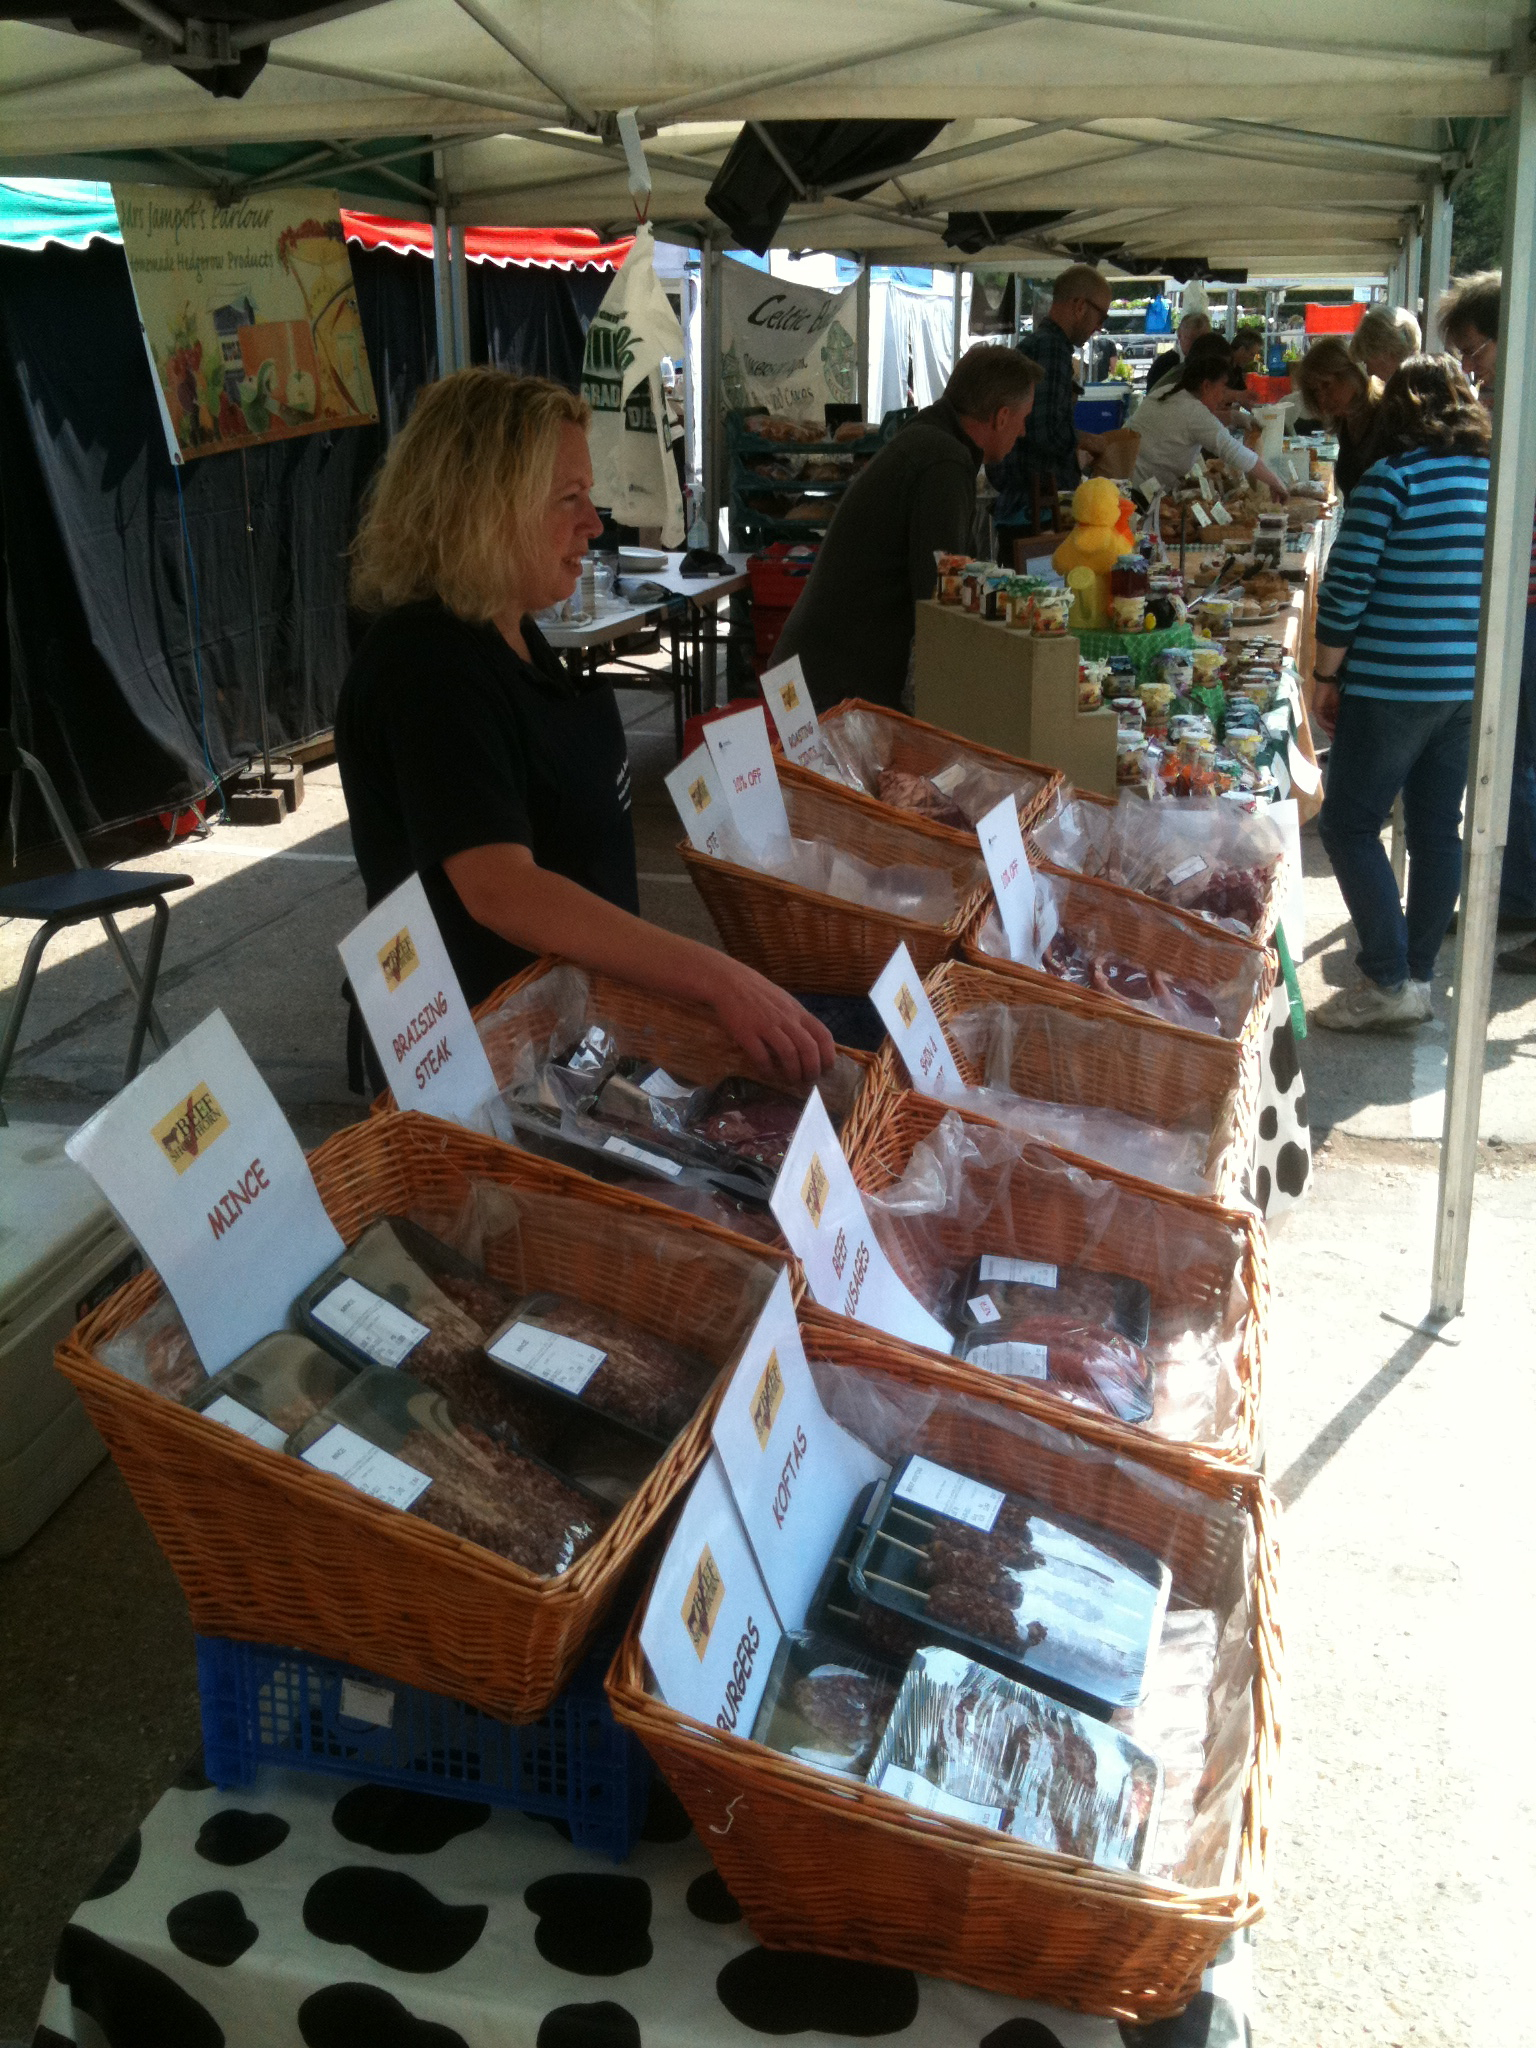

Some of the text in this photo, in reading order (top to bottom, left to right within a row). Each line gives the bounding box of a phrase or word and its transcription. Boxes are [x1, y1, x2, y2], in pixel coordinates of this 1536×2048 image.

[747, 294, 811, 332] Celtic
[747, 767, 762, 786] OFF
[393, 991, 449, 1063] BRAISING
[414, 1036, 452, 1090] STEAK
[206, 1158, 272, 1241] MINCE
[831, 1226, 848, 1281] BEEF
[843, 1239, 870, 1318] AUSAGES
[771, 1424, 808, 1530] KOFTAS
[716, 1615, 760, 1731] BURGERS
